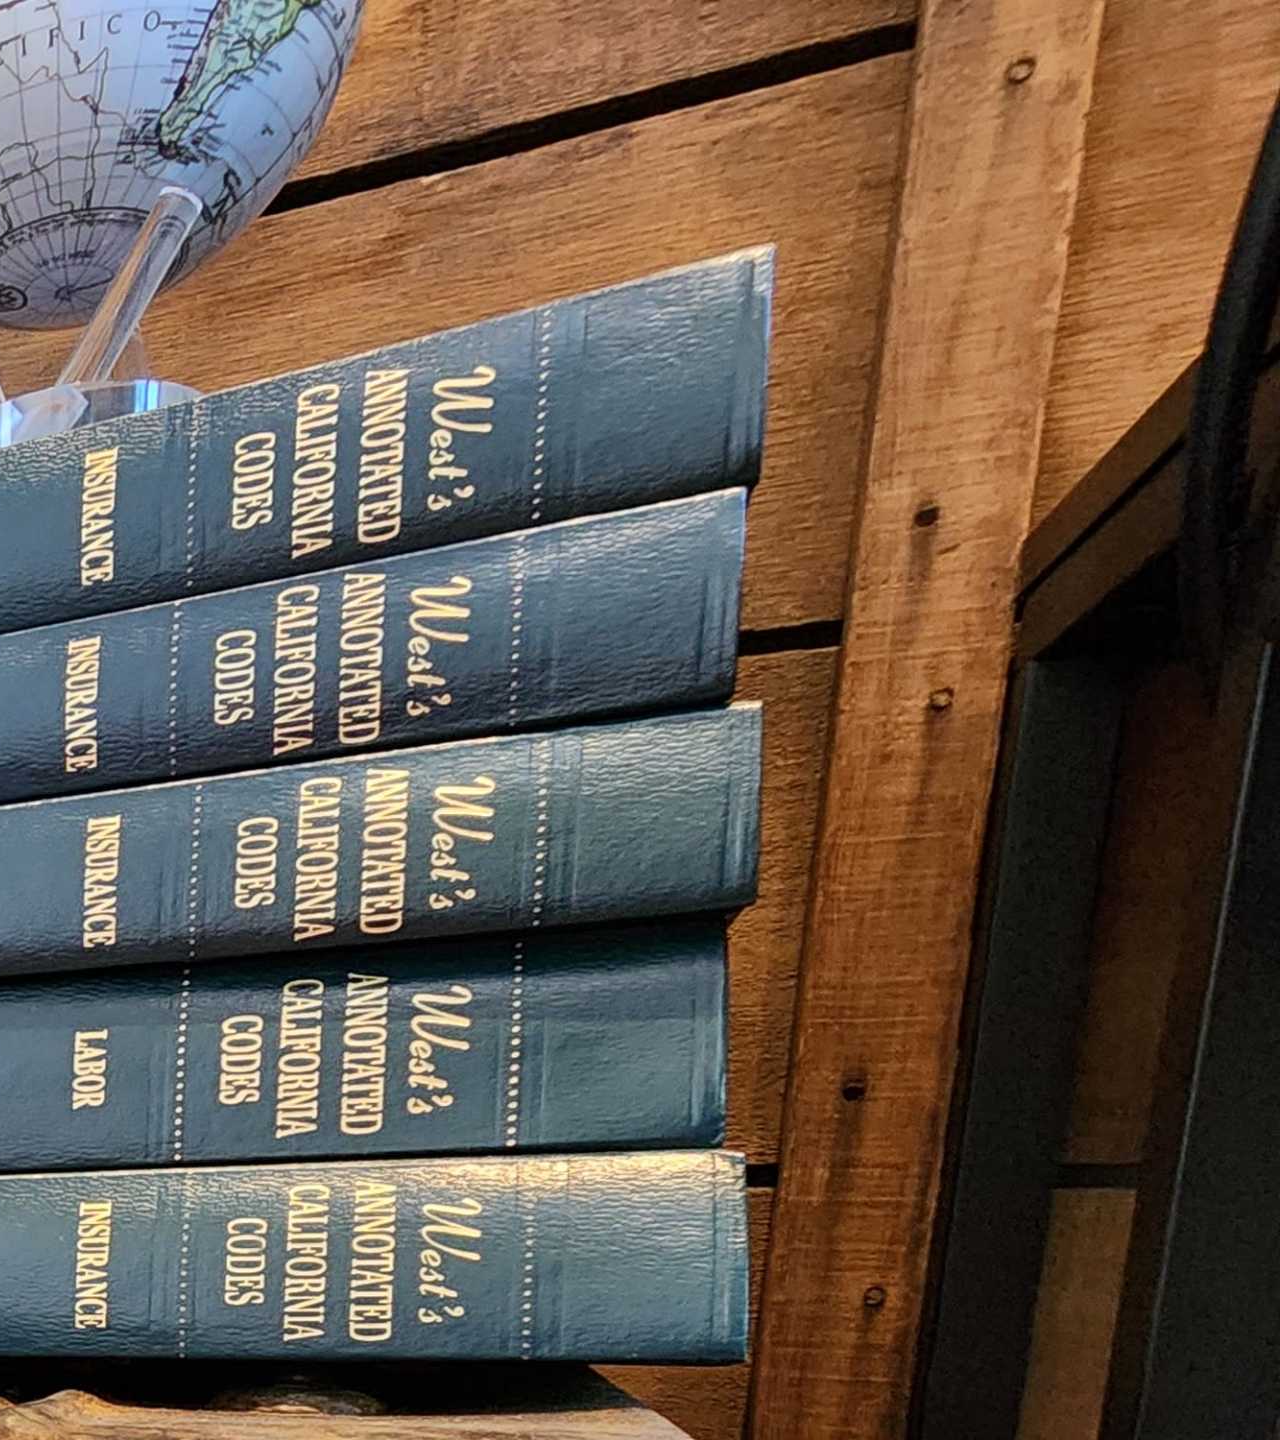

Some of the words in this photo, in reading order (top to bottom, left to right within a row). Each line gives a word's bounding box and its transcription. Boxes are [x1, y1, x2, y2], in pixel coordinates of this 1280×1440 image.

[232, 431, 276, 531] CODES
[290, 383, 341, 560] CALIFORNIA
[356, 369, 409, 545] ANNOTATED
[426, 365, 497, 512] West's
[80, 448, 118, 587] INSURANCE
[64, 635, 102, 773] INSURANCE
[212, 629, 257, 727] CODES
[272, 584, 320, 757] CALIFORNIA
[338, 573, 387, 746] ANNOTATED
[406, 576, 473, 717] West's
[82, 815, 122, 947] INSURANCE
[233, 816, 279, 910] CODES
[292, 777, 344, 943] CALIFORNIA
[359, 768, 410, 936] ANNOTATED
[429, 775, 495, 911] West's
[71, 1029, 109, 1110] LABOR
[218, 1013, 263, 1107] CODES
[275, 978, 325, 1139] CALIFORNIA
[339, 973, 390, 1137] ANNOTATED
[407, 984, 474, 1116] West's
[74, 1200, 114, 1330] INSURANCE
[224, 1217, 268, 1307] CODES
[282, 1186, 330, 1344] CALIFORNIA
[347, 1180, 397, 1344] ANNOTATED
[418, 1197, 483, 1326] West's
